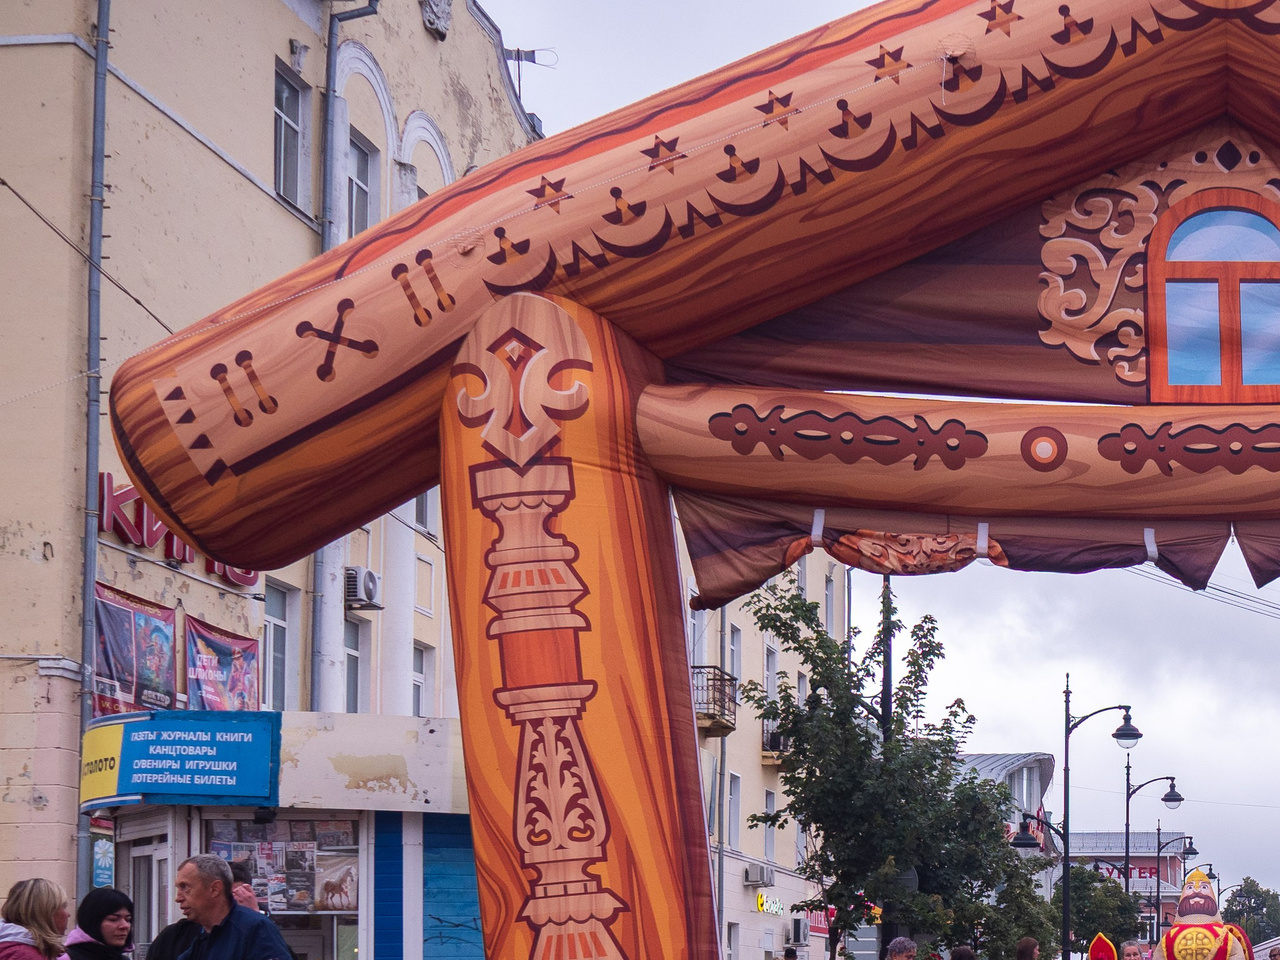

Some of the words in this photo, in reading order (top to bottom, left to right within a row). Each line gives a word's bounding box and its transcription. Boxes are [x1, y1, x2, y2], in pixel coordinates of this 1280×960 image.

[131, 731, 157, 741] ГАЗЕТЫ
[160, 731, 211, 741] ЖУРНАЛЫ
[215, 732, 252, 742] КНИГИ
[149, 745, 217, 757] КАНЦТОВАРЫ
[133, 759, 180, 769] СУВЕНИРЫ
[185, 760, 237, 771] ИГРУШКИ
[131, 771, 192, 783] ЛОТЕРЕЙНЫЕ
[194, 775, 237, 785] БИЛЕТЫ
